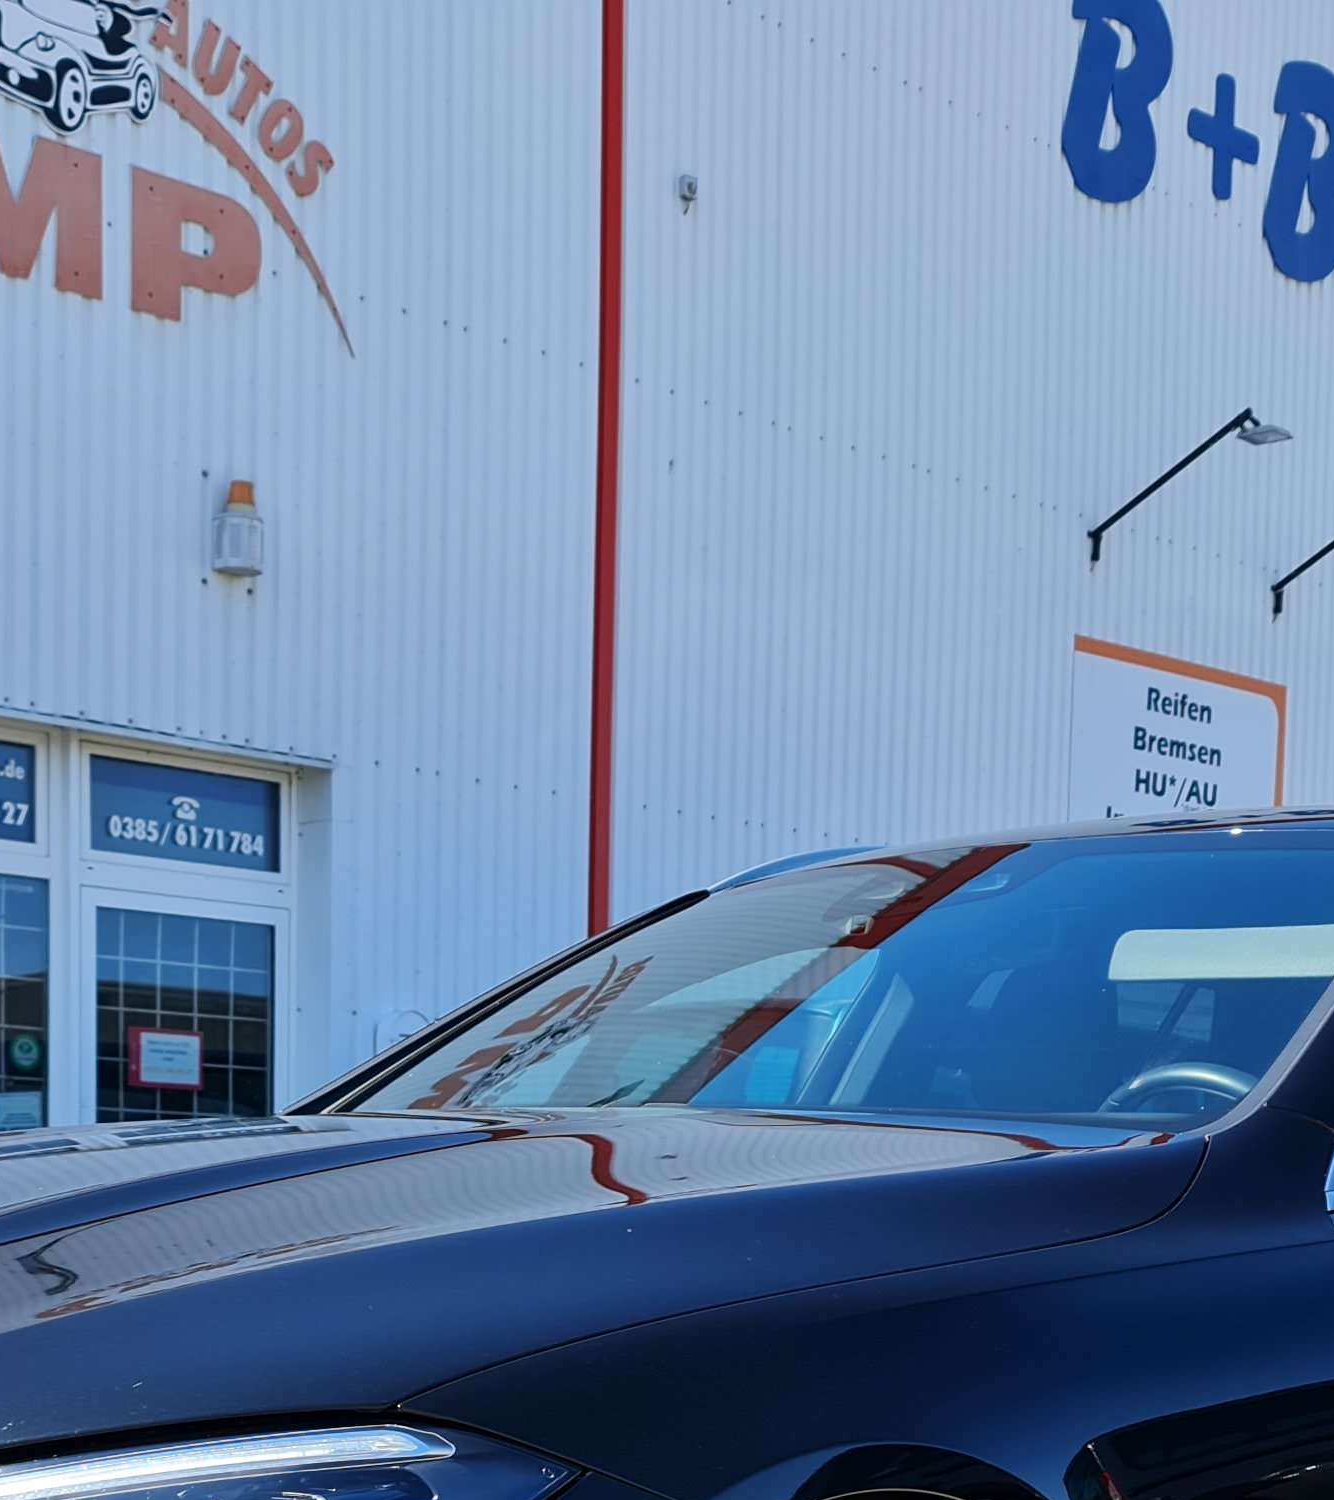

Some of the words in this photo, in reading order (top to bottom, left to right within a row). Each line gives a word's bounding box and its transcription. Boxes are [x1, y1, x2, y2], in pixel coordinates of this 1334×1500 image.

[149, 0, 334, 197] AUTOS
[1146, 686, 1212, 724] Reifen
[1133, 726, 1221, 766] Bremsen
